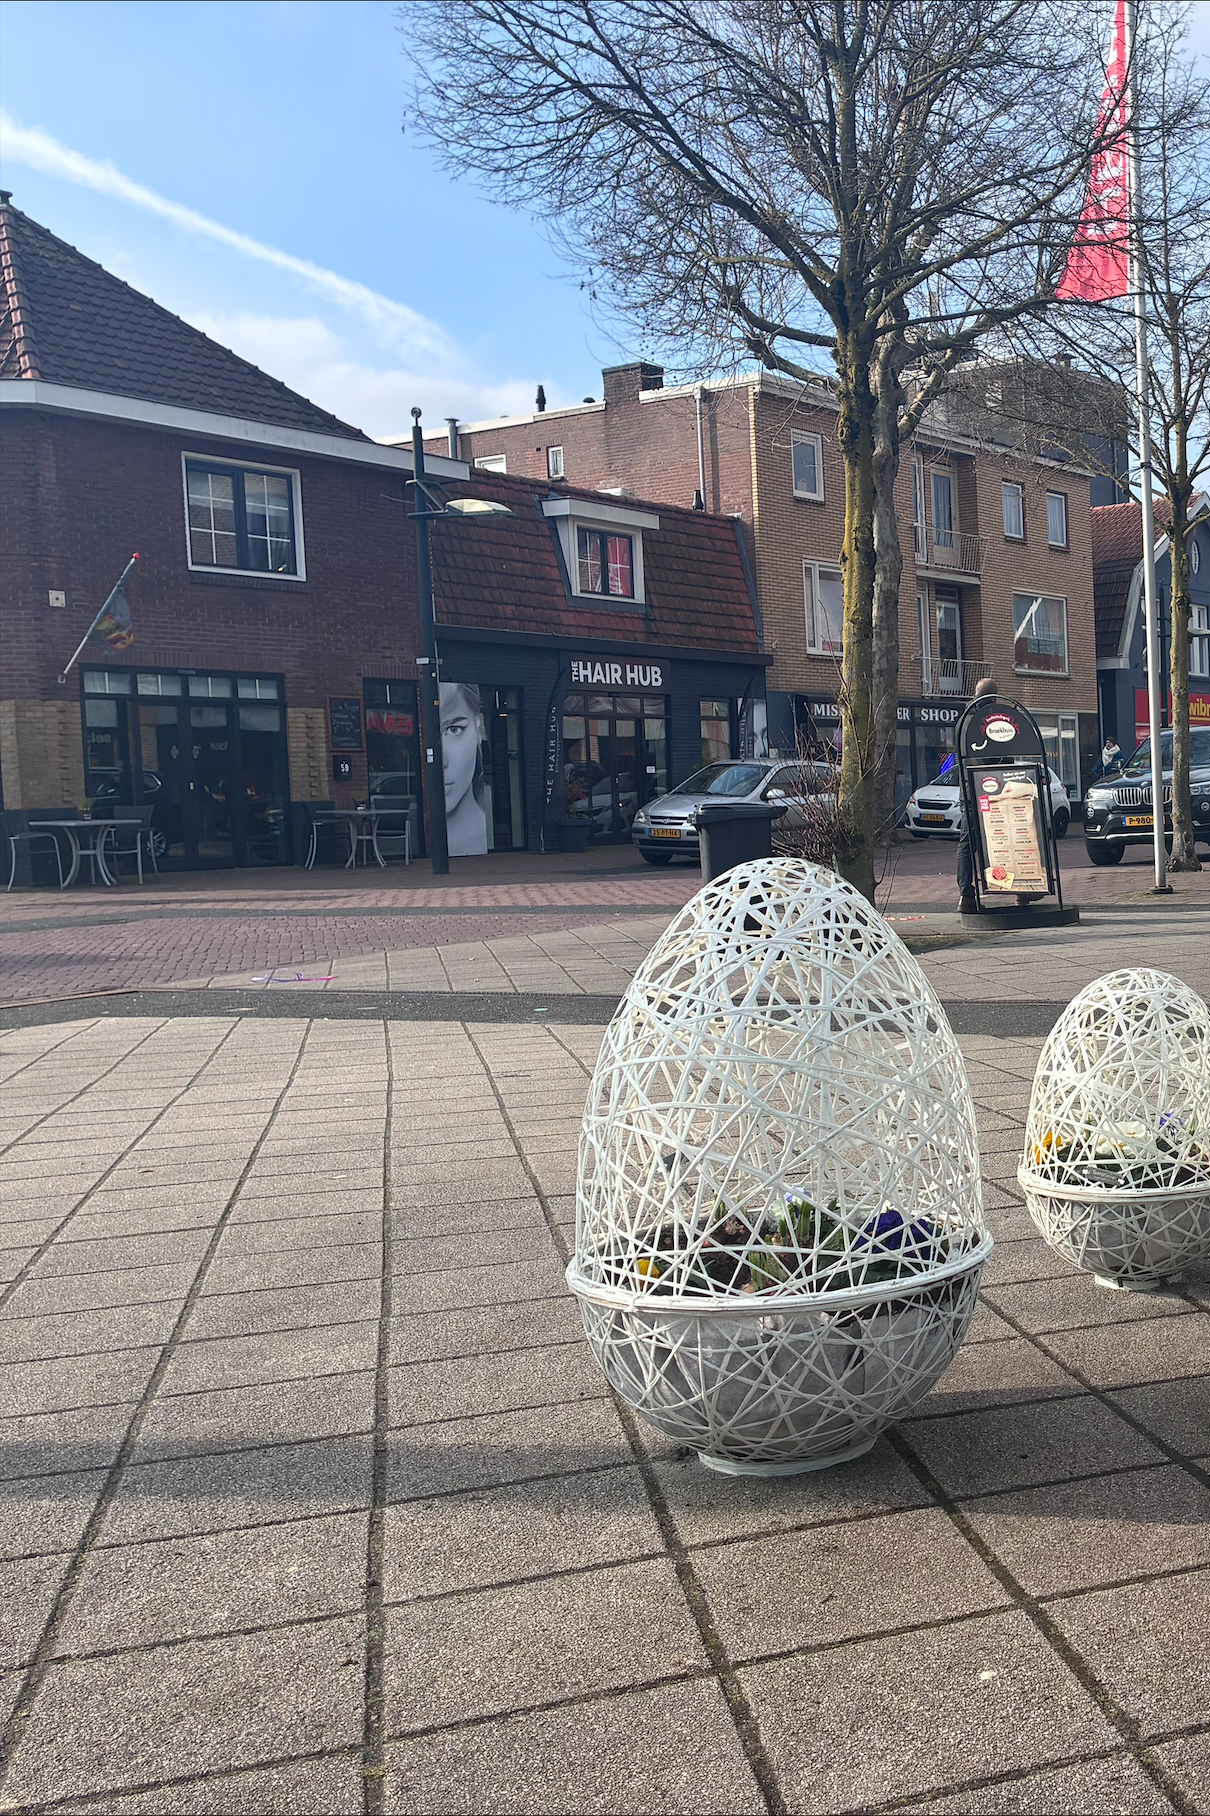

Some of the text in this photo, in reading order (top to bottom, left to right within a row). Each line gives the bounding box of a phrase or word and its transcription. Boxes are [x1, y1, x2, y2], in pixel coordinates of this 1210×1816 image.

[571, 660, 663, 687] THE HAIR HUB
[813, 703, 841, 717] MIS
[920, 708, 959, 722] SHOP
[988, 726, 1014, 735] Broekhuis
[340, 763, 350, 772] 59
[1128, 816, 1154, 825] P-980-
